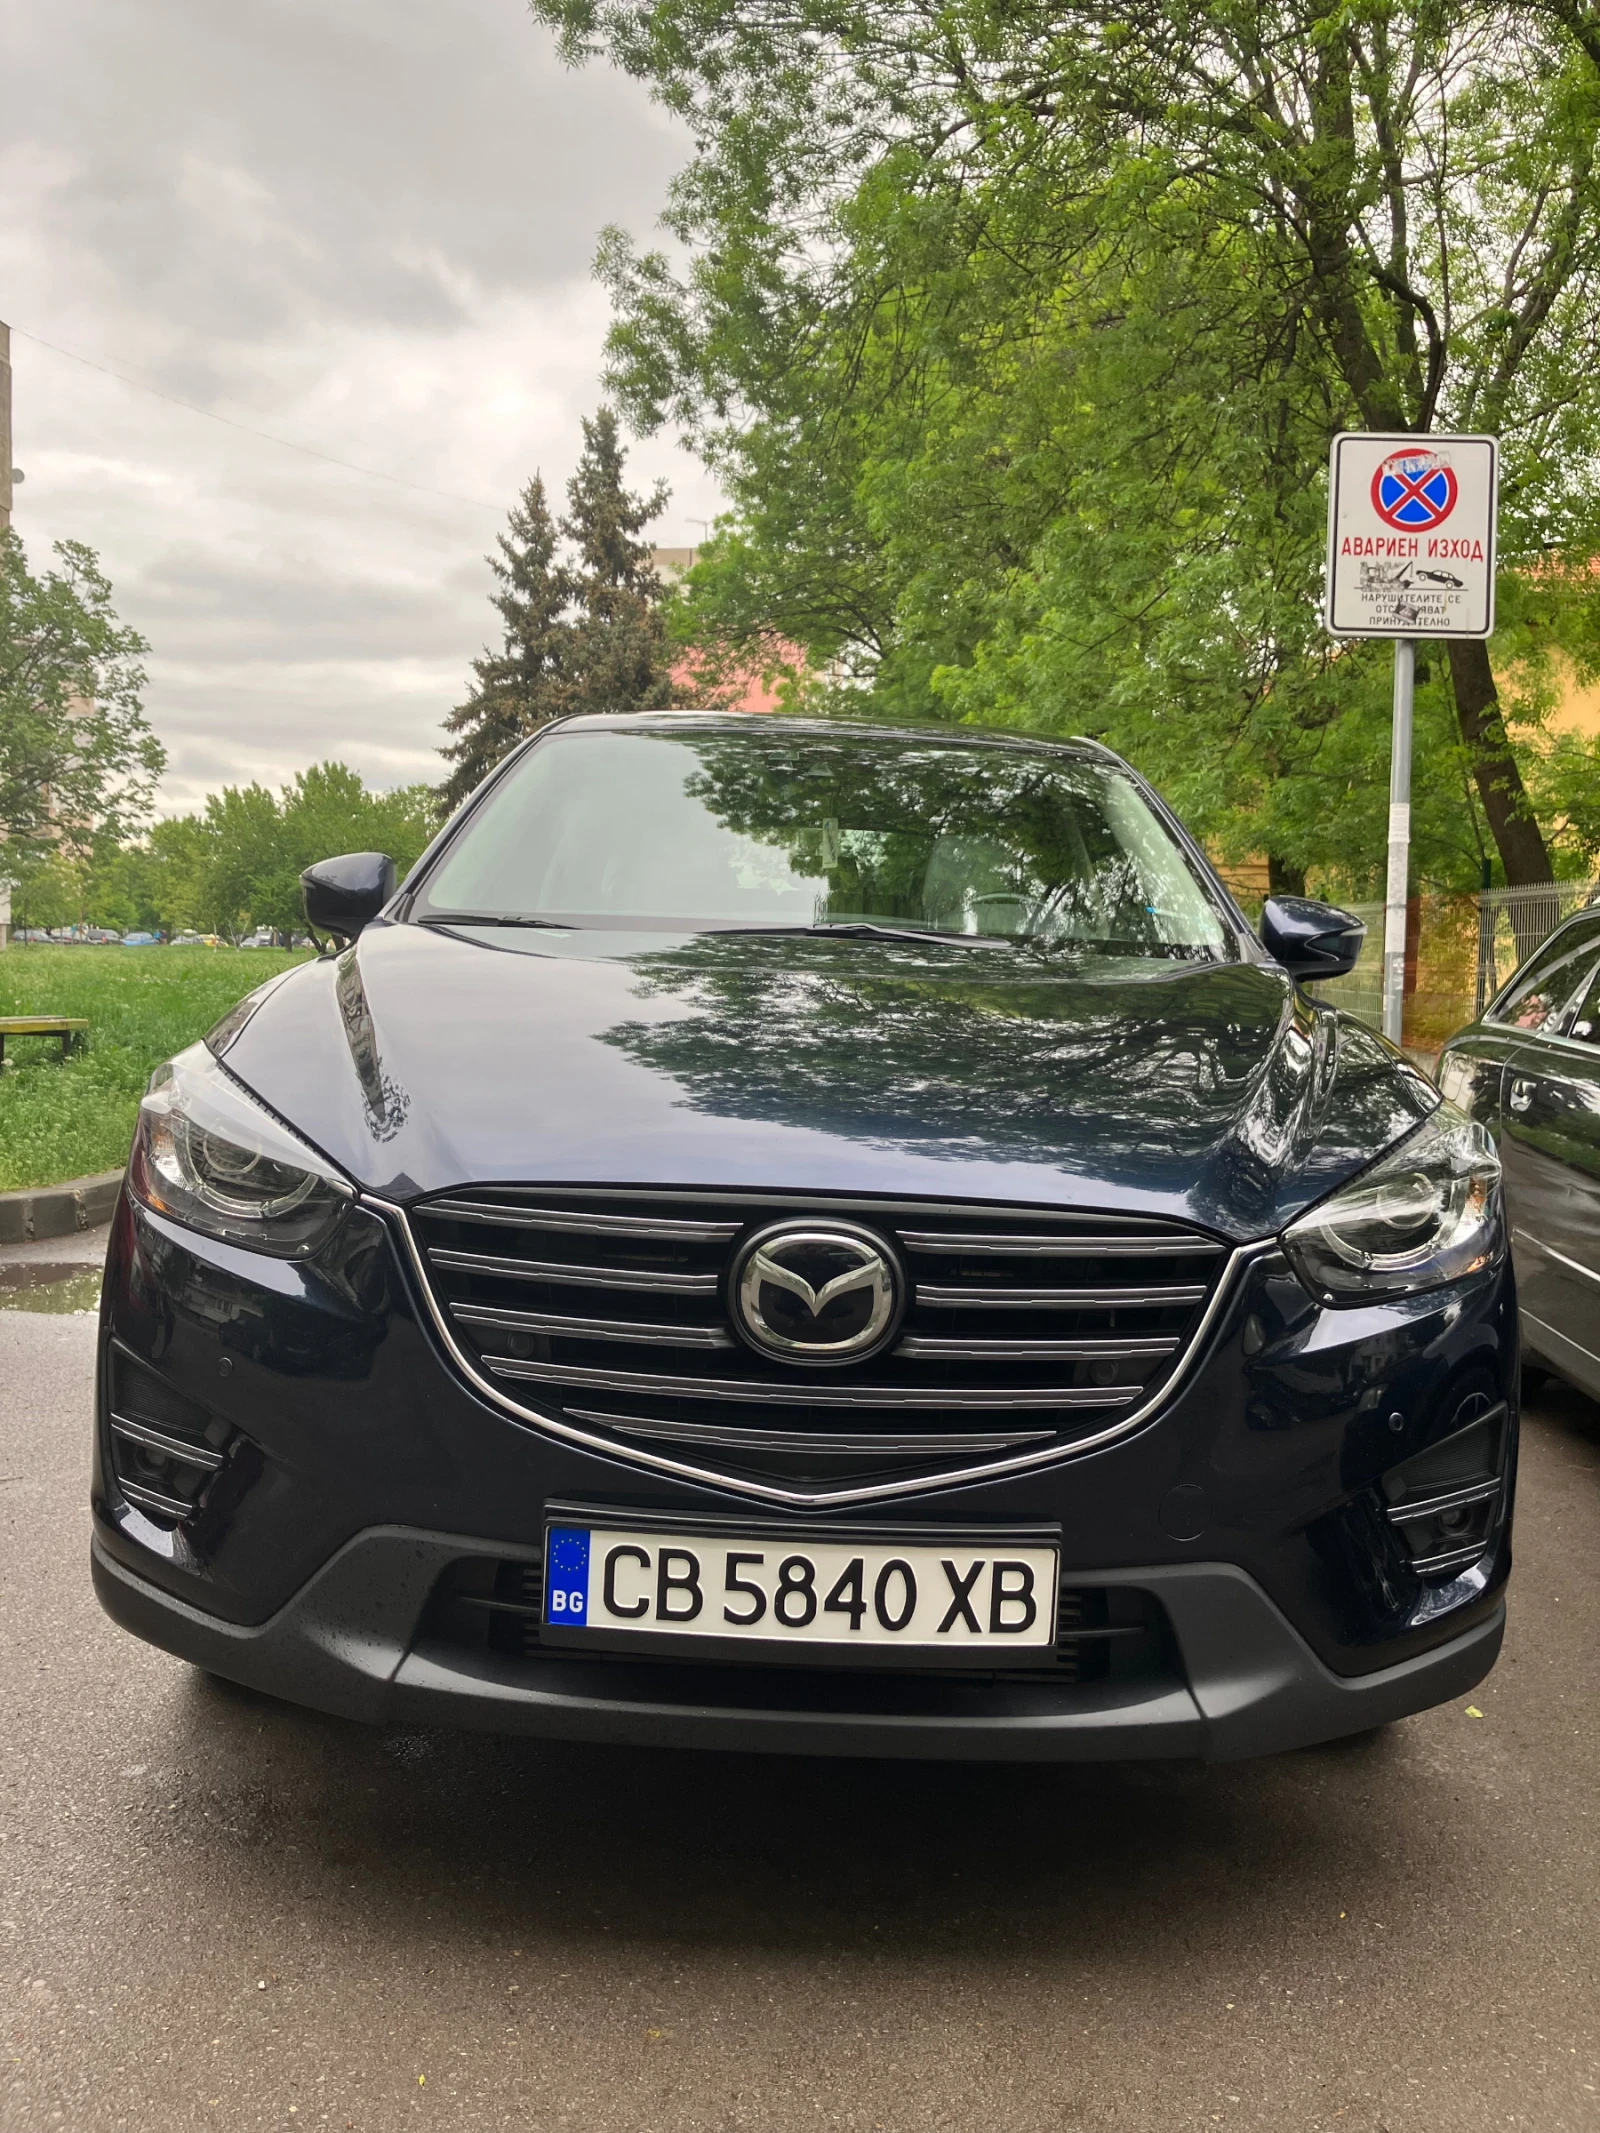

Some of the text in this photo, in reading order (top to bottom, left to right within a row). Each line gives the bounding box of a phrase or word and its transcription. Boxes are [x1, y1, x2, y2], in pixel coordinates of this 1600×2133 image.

[1341, 536, 1484, 562] АВАРИЕН ИЗХОД
[1361, 593, 1461, 604] НАРУШИТЕЛИТЕ СЕ
[1375, 604, 1446, 615] ОТСЯВАТ
[551, 1589, 584, 1612] BG
[603, 1544, 1038, 1634] CB 5840 XB
